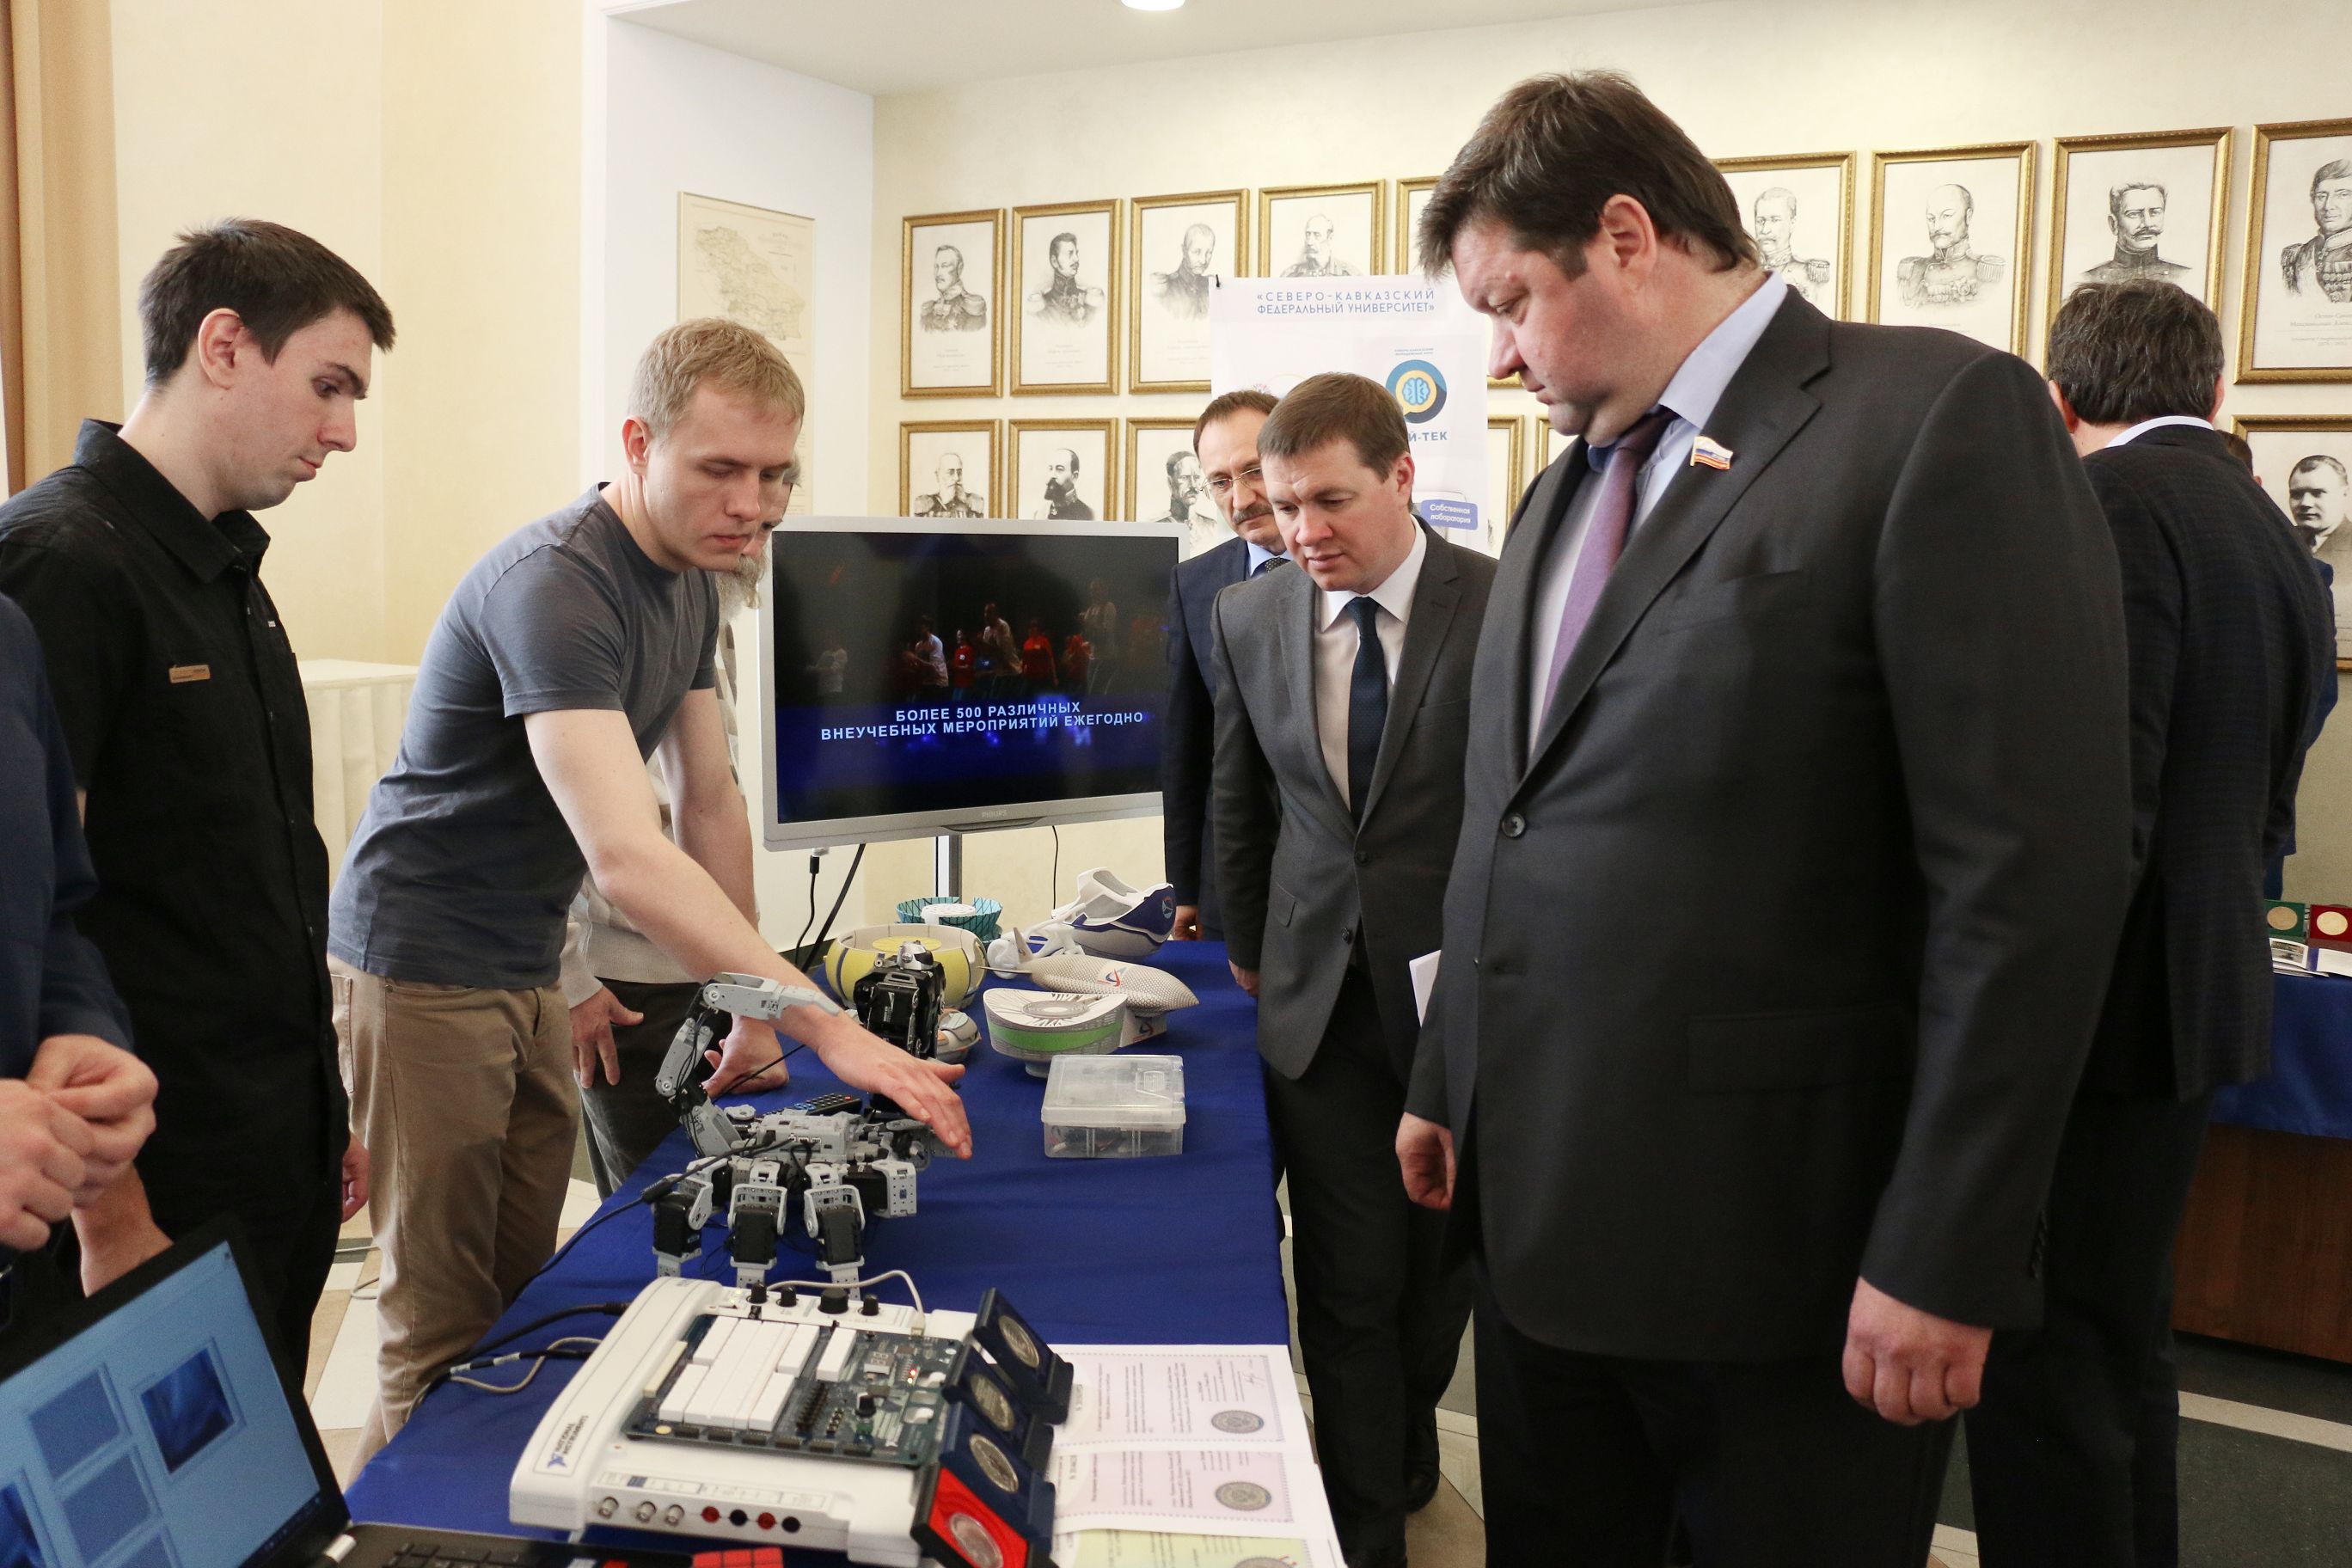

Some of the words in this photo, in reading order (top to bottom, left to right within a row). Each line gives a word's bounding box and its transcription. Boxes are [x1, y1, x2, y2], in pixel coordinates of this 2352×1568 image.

[1257, 288, 1434, 302] «СЕВЕРО-КАВКАЗСКИЙ
[1257, 302, 1344, 314] ФЕДЕРАЛЬНЫЙ
[1348, 302, 1435, 313] УНИВЕРСИТЕТ»
[1408, 431, 1448, 442] Й-ТЕК
[896, 708, 950, 722] БОЛЕЕ
[956, 707, 982, 719] 500
[988, 701, 1081, 717] РАЗЛИЧНЫХ
[821, 723, 936, 740] ВНЕУЧЕБНЫХ
[943, 714, 1058, 733] МЕРОПРИЯТИЙ
[1064, 712, 1143, 726] ЕЖЕГОДНО
